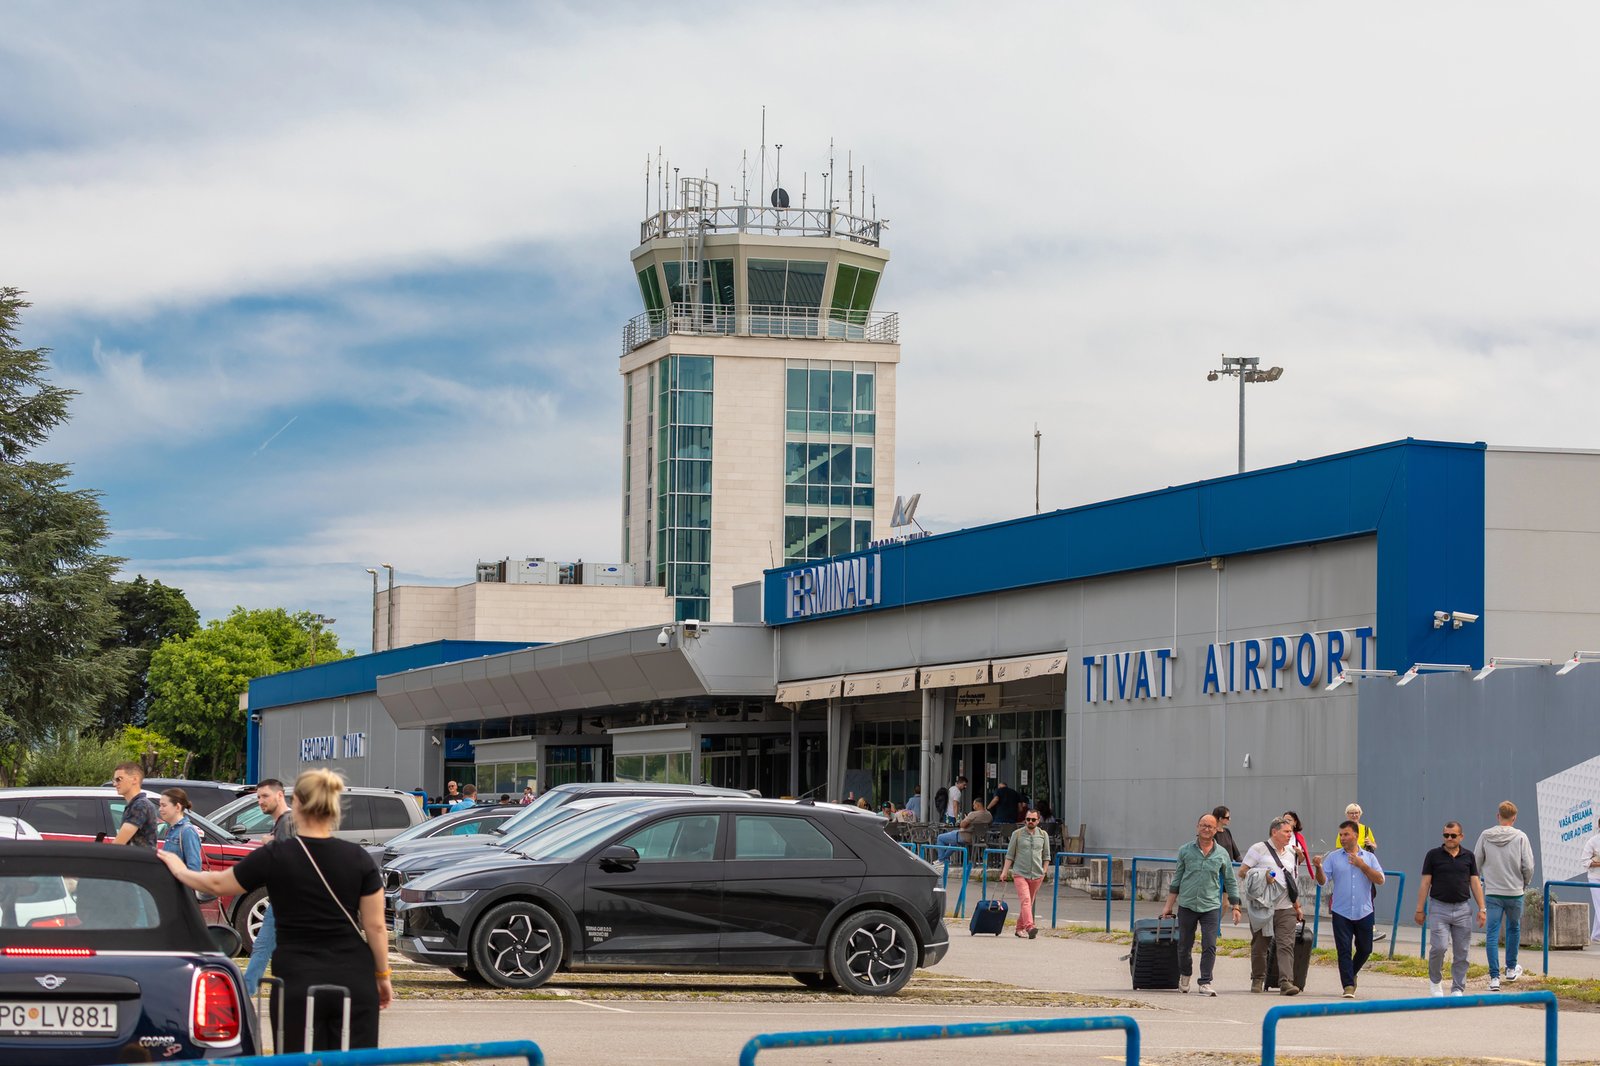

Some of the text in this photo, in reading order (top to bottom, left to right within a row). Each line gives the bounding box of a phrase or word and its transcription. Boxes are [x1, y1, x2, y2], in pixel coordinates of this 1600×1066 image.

[782, 556, 872, 619] TERMINAL
[1083, 626, 1375, 703] TIVAT AIRPORT
[300, 732, 365, 762] AERODROM TIVAT
[1561, 830, 1573, 842] YOUR
[1582, 821, 1592, 834] HERE
[0, 1005, 113, 1028] PG LV881
[139, 1036, 175, 1048] COOPER
[162, 1043, 183, 1057] SD
